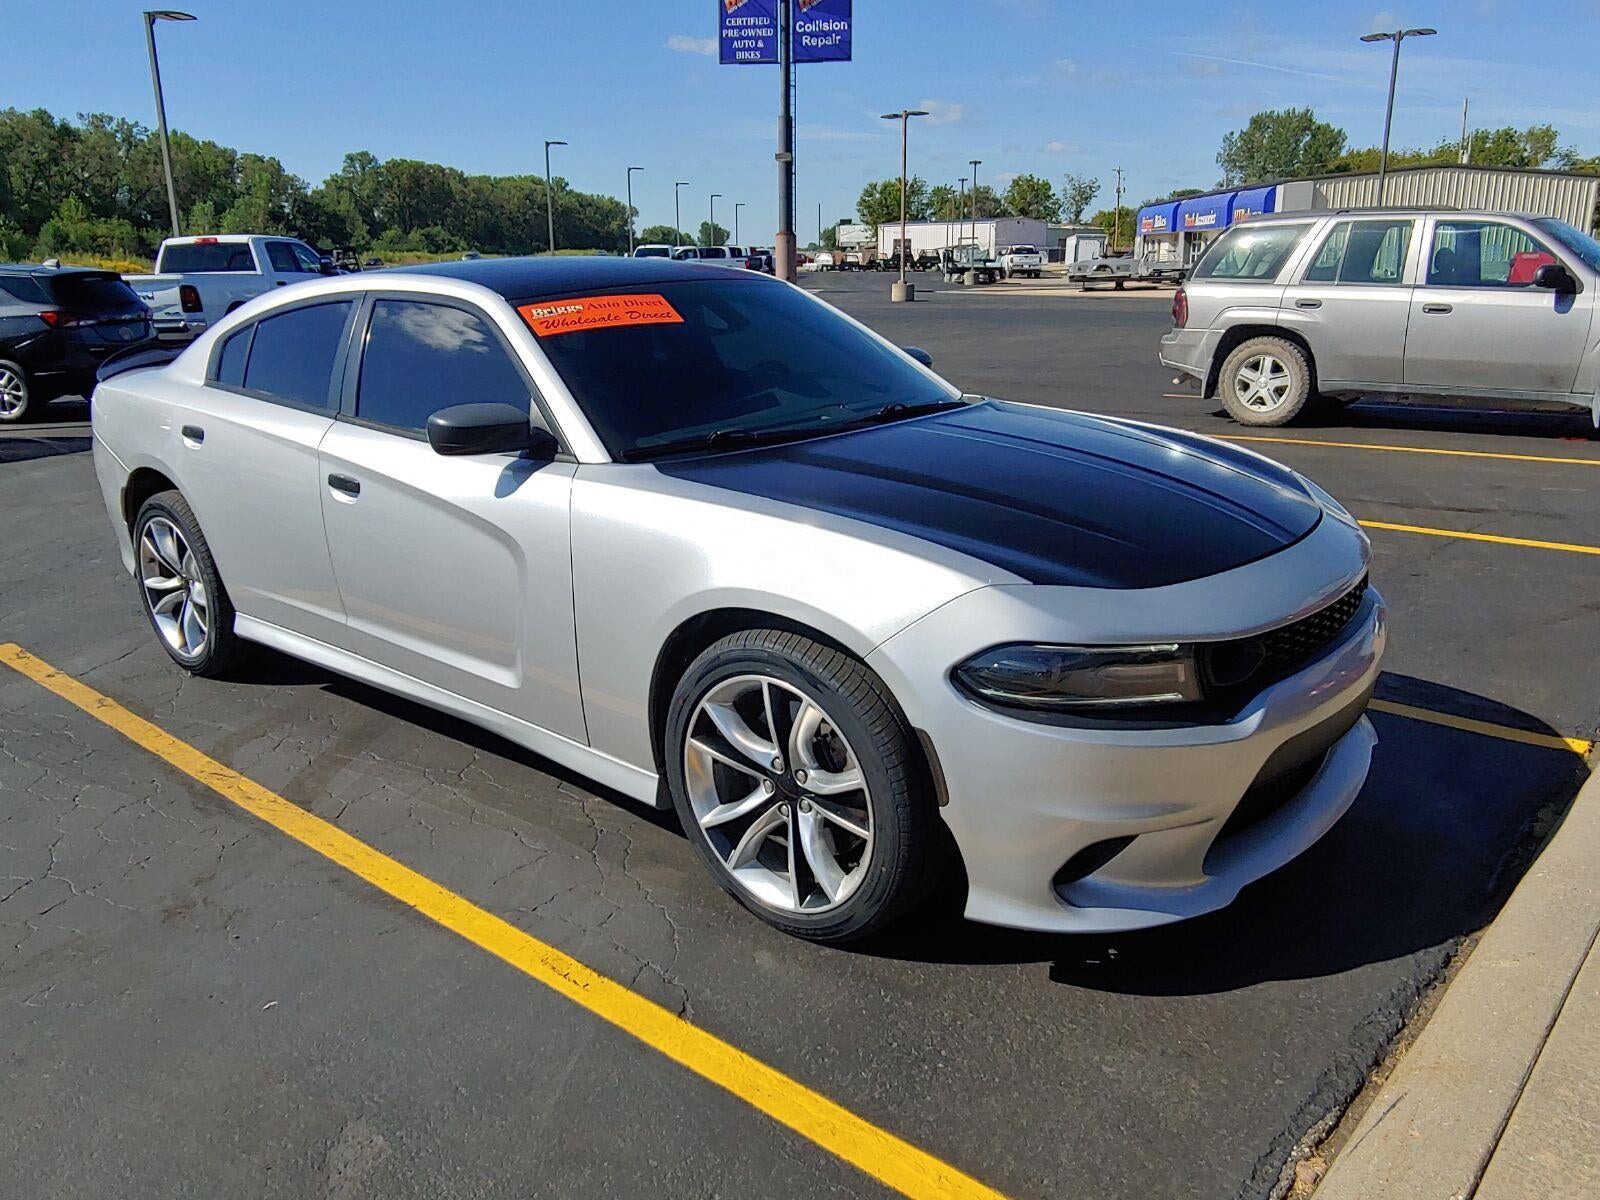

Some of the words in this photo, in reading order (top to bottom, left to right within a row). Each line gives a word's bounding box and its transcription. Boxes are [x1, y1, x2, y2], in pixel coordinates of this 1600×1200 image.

[726, 17, 770, 26] CERTIFIED
[796, 19, 848, 33] Collision
[722, 28, 774, 38] PRE-OWNED
[732, 39, 755, 49] AUTO
[757, 39, 764, 48] &
[802, 34, 841, 47] Repair
[736, 50, 761, 59] BIKES
[531, 304, 584, 319] Briggs
[587, 302, 620, 311] Auto
[623, 299, 664, 307] Direct
[539, 313, 622, 329] Wholesale
[625, 310, 673, 319] Direct
